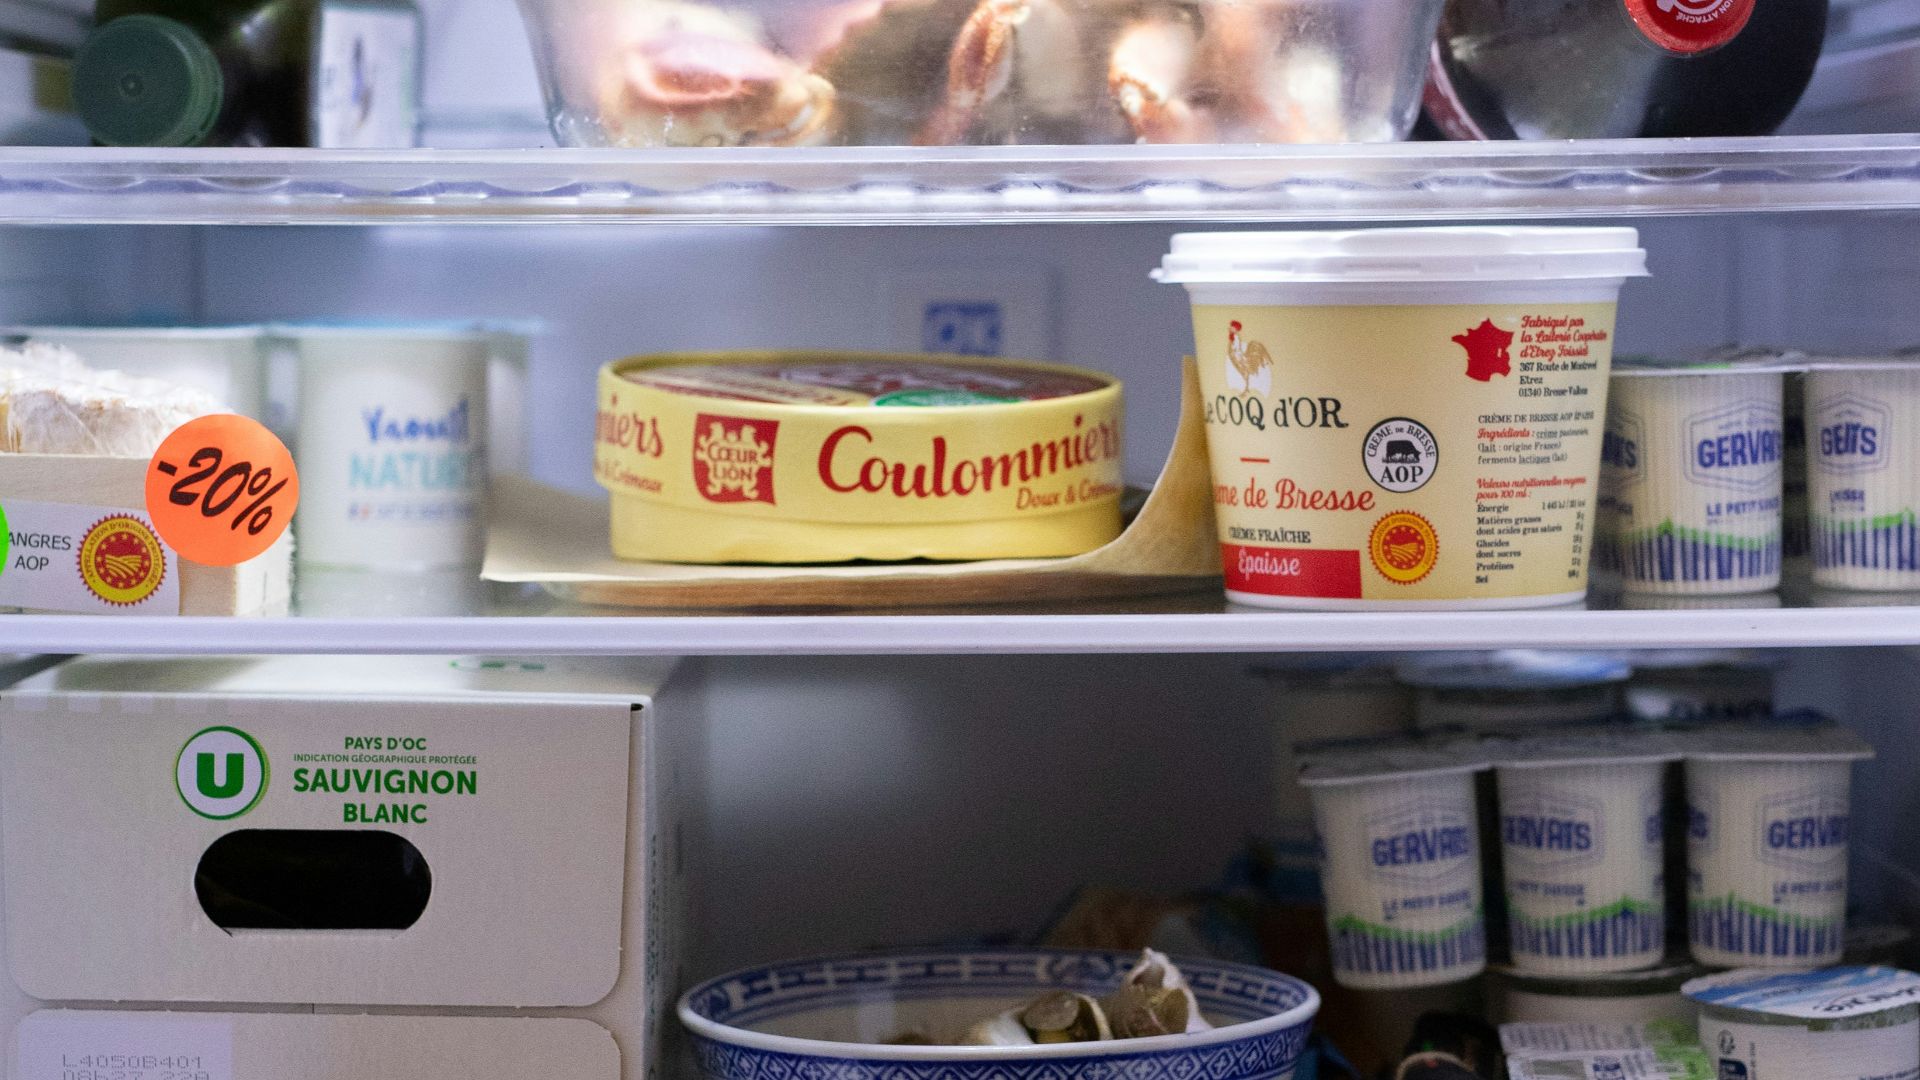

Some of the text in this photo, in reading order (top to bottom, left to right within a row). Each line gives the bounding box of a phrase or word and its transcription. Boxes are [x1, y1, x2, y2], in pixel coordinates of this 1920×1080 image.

[1536, 361, 1559, 372] Route
[1520, 375, 1543, 385] Etrez
[1216, 394, 1266, 431] COQ
[1273, 397, 1350, 428] d'OR
[1478, 412, 1512, 424] CRÈME
[1515, 414, 1527, 423] DE
[1407, 425, 1435, 458] BRESSE
[1503, 442, 1532, 453] origine
[1478, 454, 1516, 465] ferments
[1380, 465, 1424, 483] AOP
[157, 447, 289, 536] -20%
[1243, 477, 1268, 508] de
[1275, 478, 1376, 511] Bresse
[8, 530, 71, 551] ANGRES
[1258, 527, 1312, 544] FRAÎCHE
[15, 555, 49, 571] AOP
[1238, 546, 1301, 580] Épaisse
[344, 737, 427, 751] PAYS D'OC
[293, 752, 477, 765] INDICATION GÉOGRAPHIQUE PROTÉGÉE
[197, 753, 244, 798] U
[293, 767, 477, 795] SAUVIGNON
[343, 803, 428, 824] BLANC
